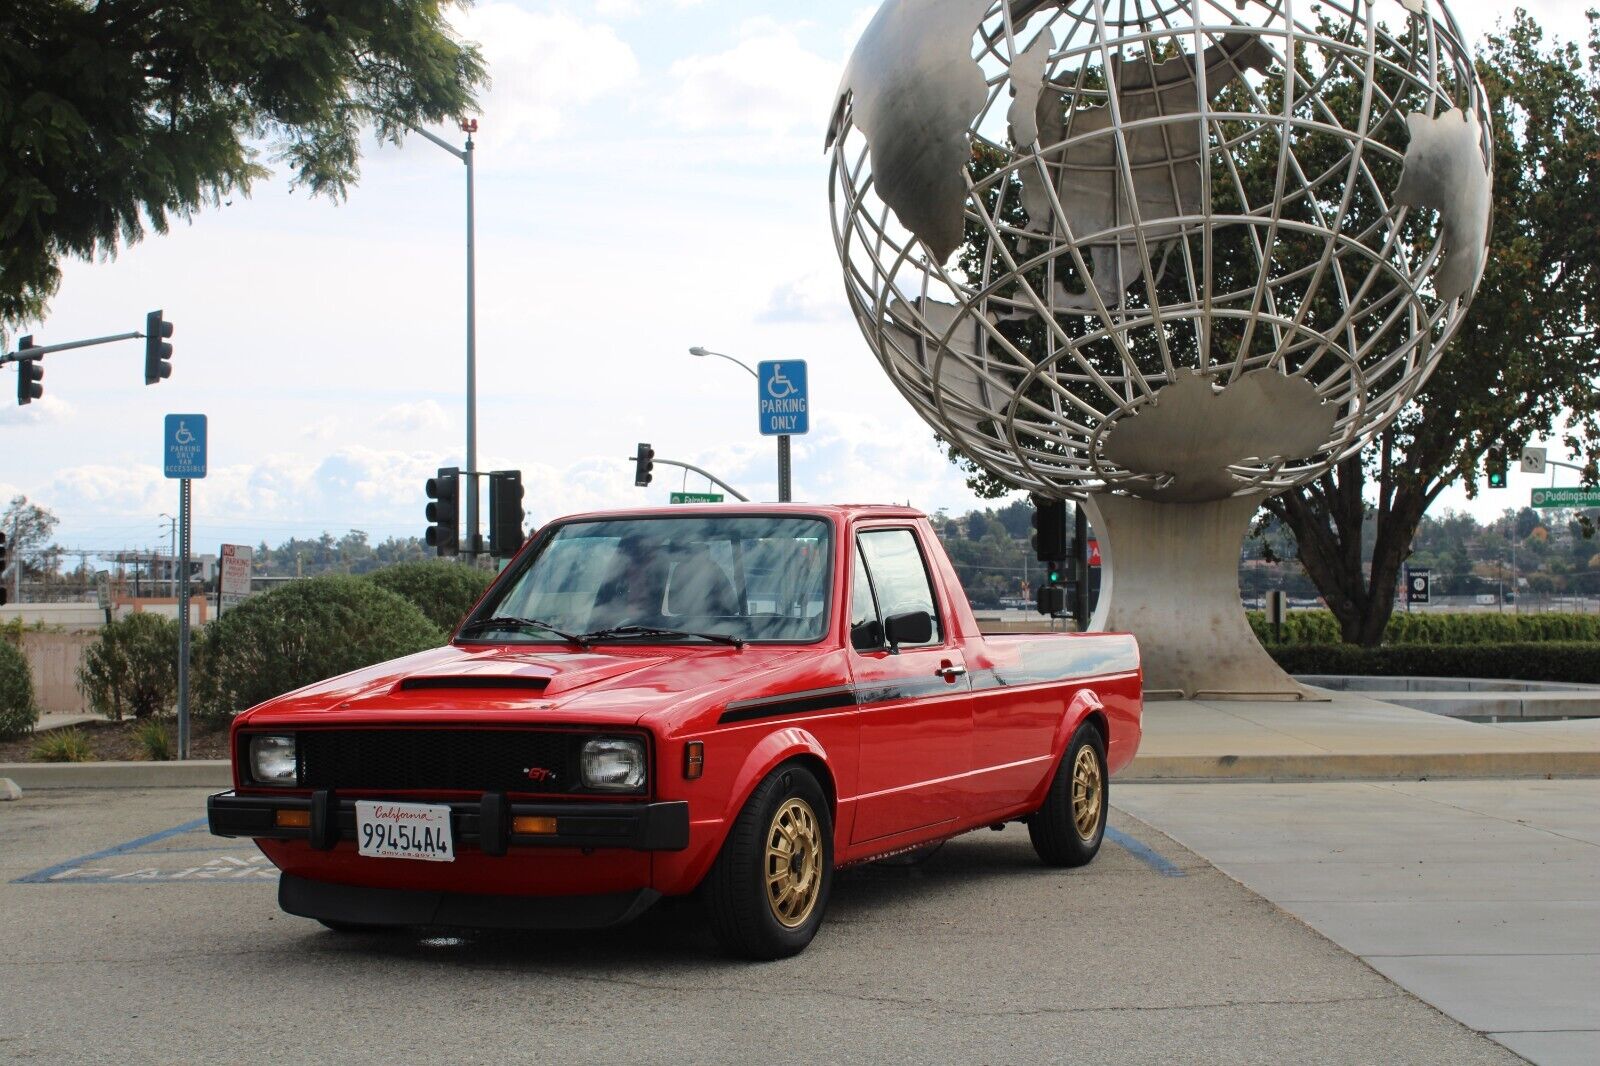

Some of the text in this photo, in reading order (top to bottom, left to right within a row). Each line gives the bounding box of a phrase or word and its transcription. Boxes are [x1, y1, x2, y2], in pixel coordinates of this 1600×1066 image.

[761, 398, 806, 413] PARKING
[771, 415, 797, 430] ONLY
[223, 545, 235, 556] NO
[225, 558, 250, 567] PARKING
[529, 767, 550, 781] GT
[374, 805, 434, 822] California
[363, 822, 448, 854] 99454A4
